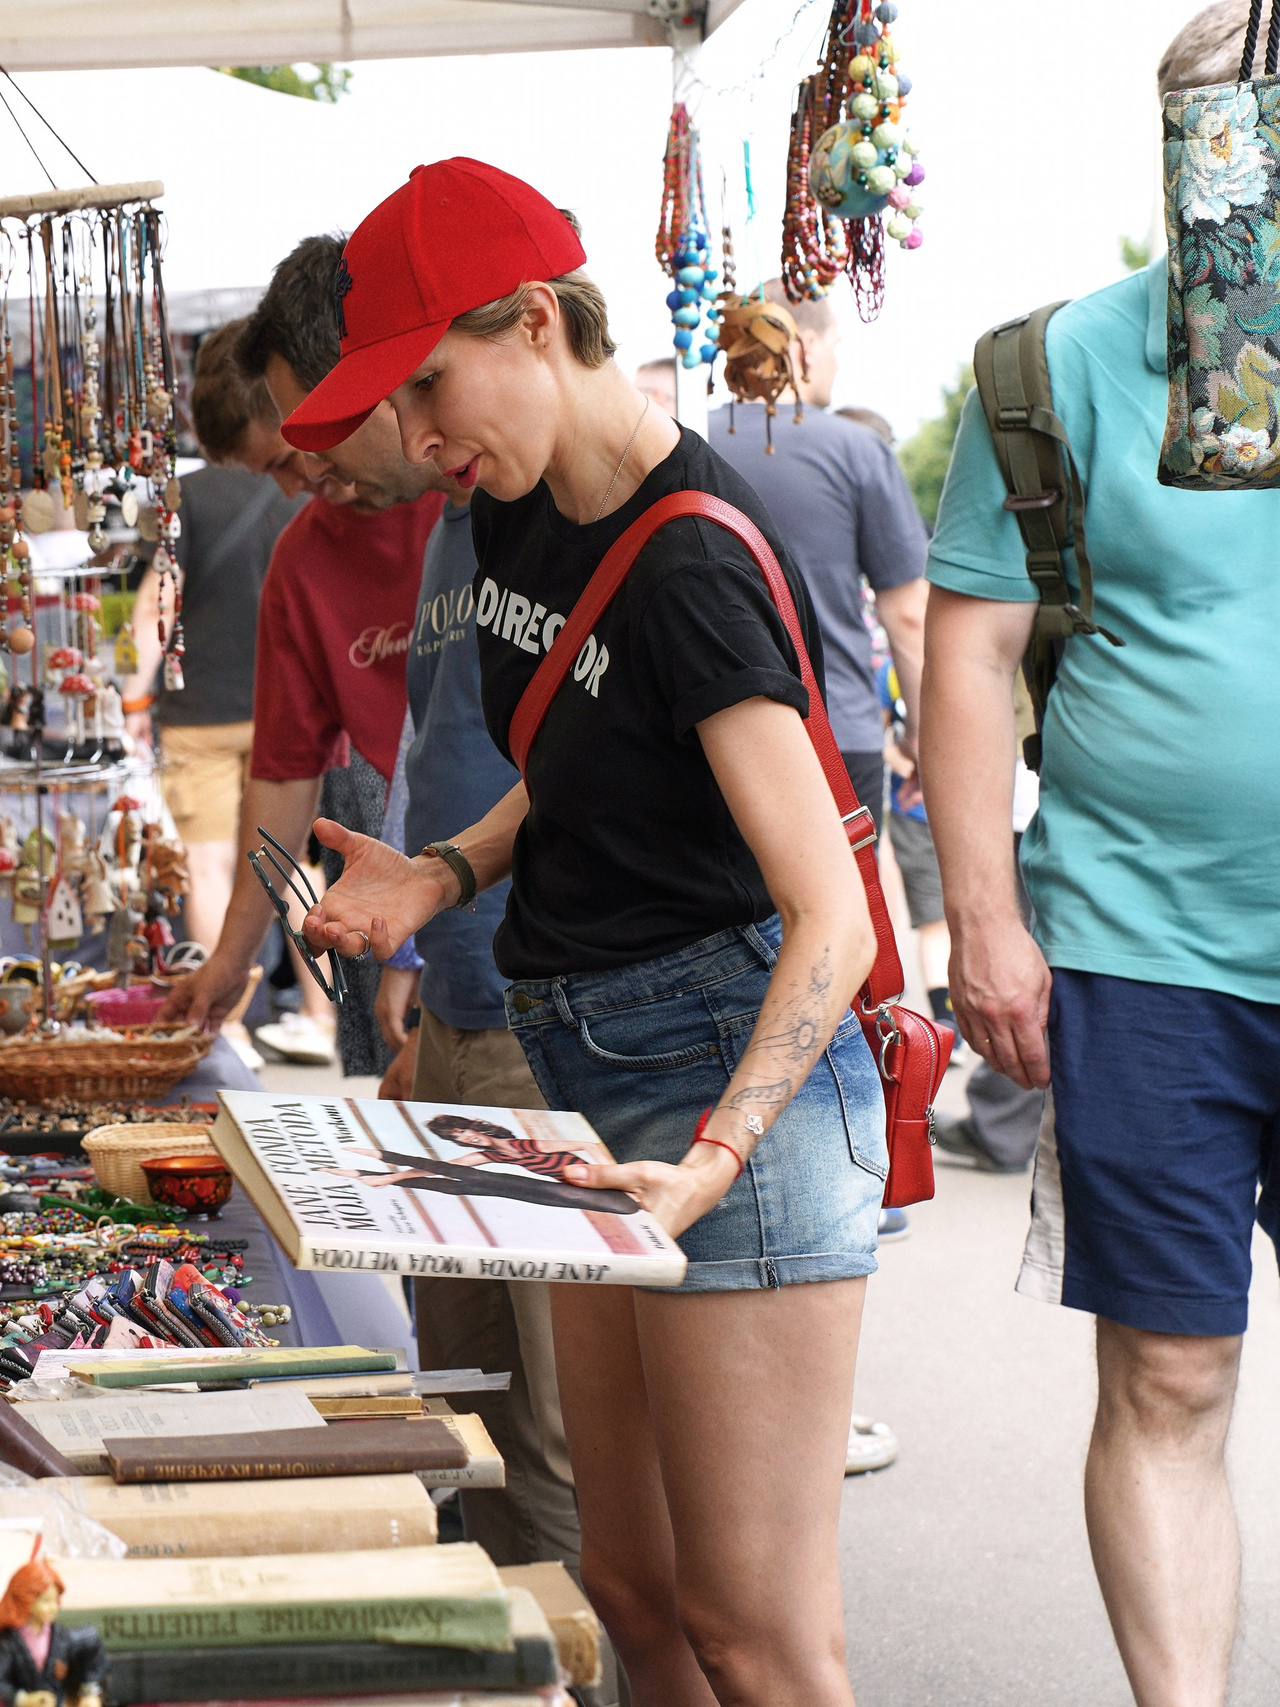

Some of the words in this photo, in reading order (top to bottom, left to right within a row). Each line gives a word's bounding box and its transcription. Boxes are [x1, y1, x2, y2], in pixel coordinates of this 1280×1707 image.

[417, 584, 474, 641] POLO
[476, 577, 610, 698] DIRECOR
[272, 1102, 341, 1174] METODA
[320, 1102, 361, 1144] Workout
[245, 1118, 308, 1176] FONDA
[284, 1182, 339, 1230] JANE
[320, 1185, 381, 1232] MOJA
[311, 1248, 402, 1271] METODA
[408, 1253, 466, 1275] MOJA
[478, 1257, 549, 1279] FONDA
[553, 1262, 611, 1281] JANE
[154, 1463, 228, 1478] ЛЕЧЕНИЕ
[102, 1611, 238, 1640] РЕЦЕПТЫ
